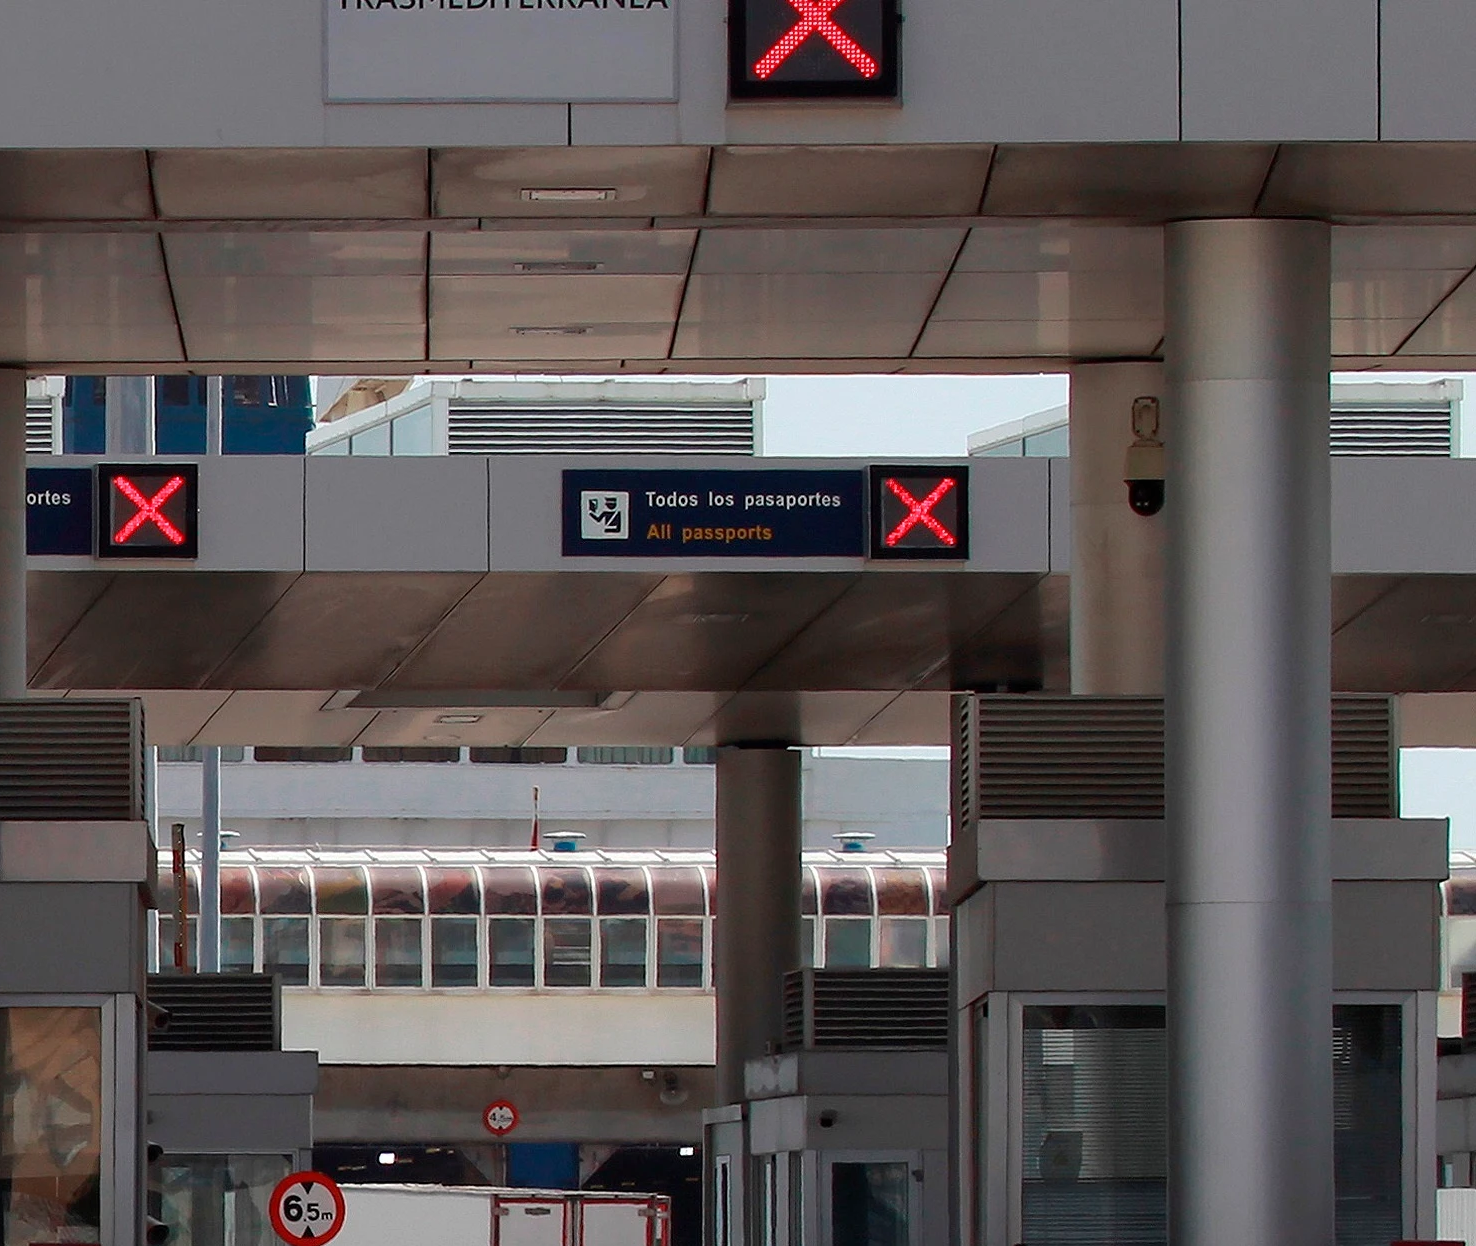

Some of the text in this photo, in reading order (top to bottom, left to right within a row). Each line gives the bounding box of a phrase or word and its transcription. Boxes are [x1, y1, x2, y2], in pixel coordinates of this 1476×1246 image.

[27, 490, 71, 505] ortes
[646, 491, 841, 510] Todos los pasaportes
[647, 524, 772, 543] All passports
